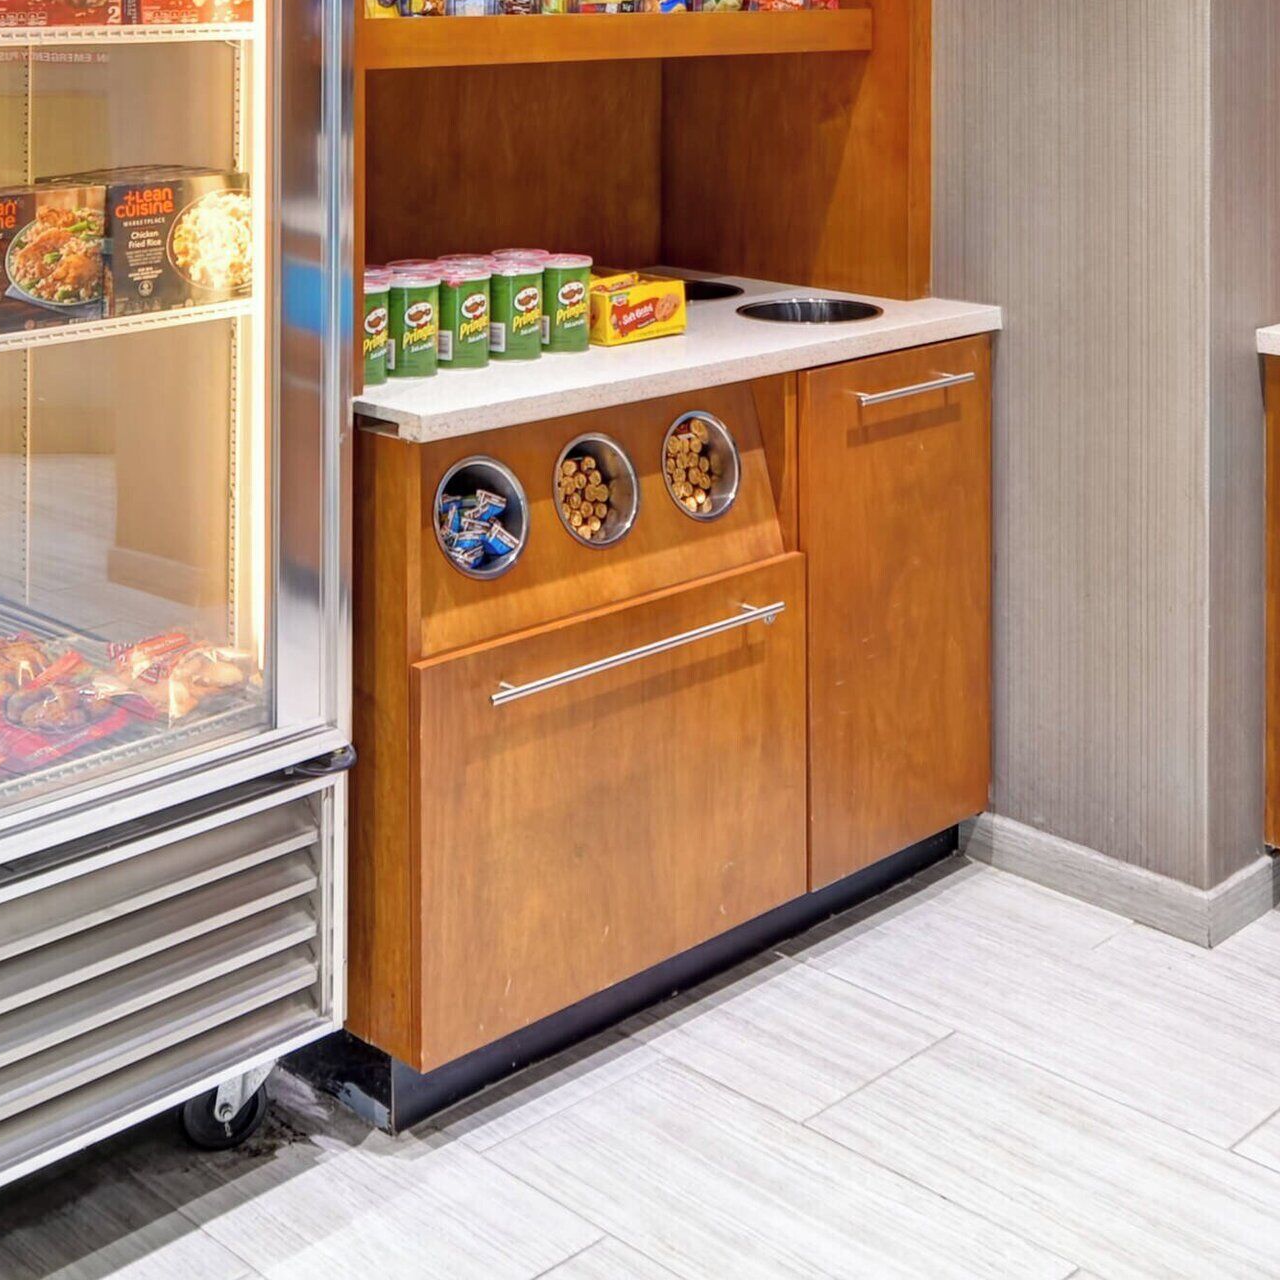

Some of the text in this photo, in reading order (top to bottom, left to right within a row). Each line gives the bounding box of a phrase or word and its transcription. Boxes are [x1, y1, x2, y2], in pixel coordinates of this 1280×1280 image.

[106, 5, 121, 24] 2
[136, 187, 173, 203] Lean
[131, 231, 160, 240] Chicken
[128, 240, 146, 249] Fried
